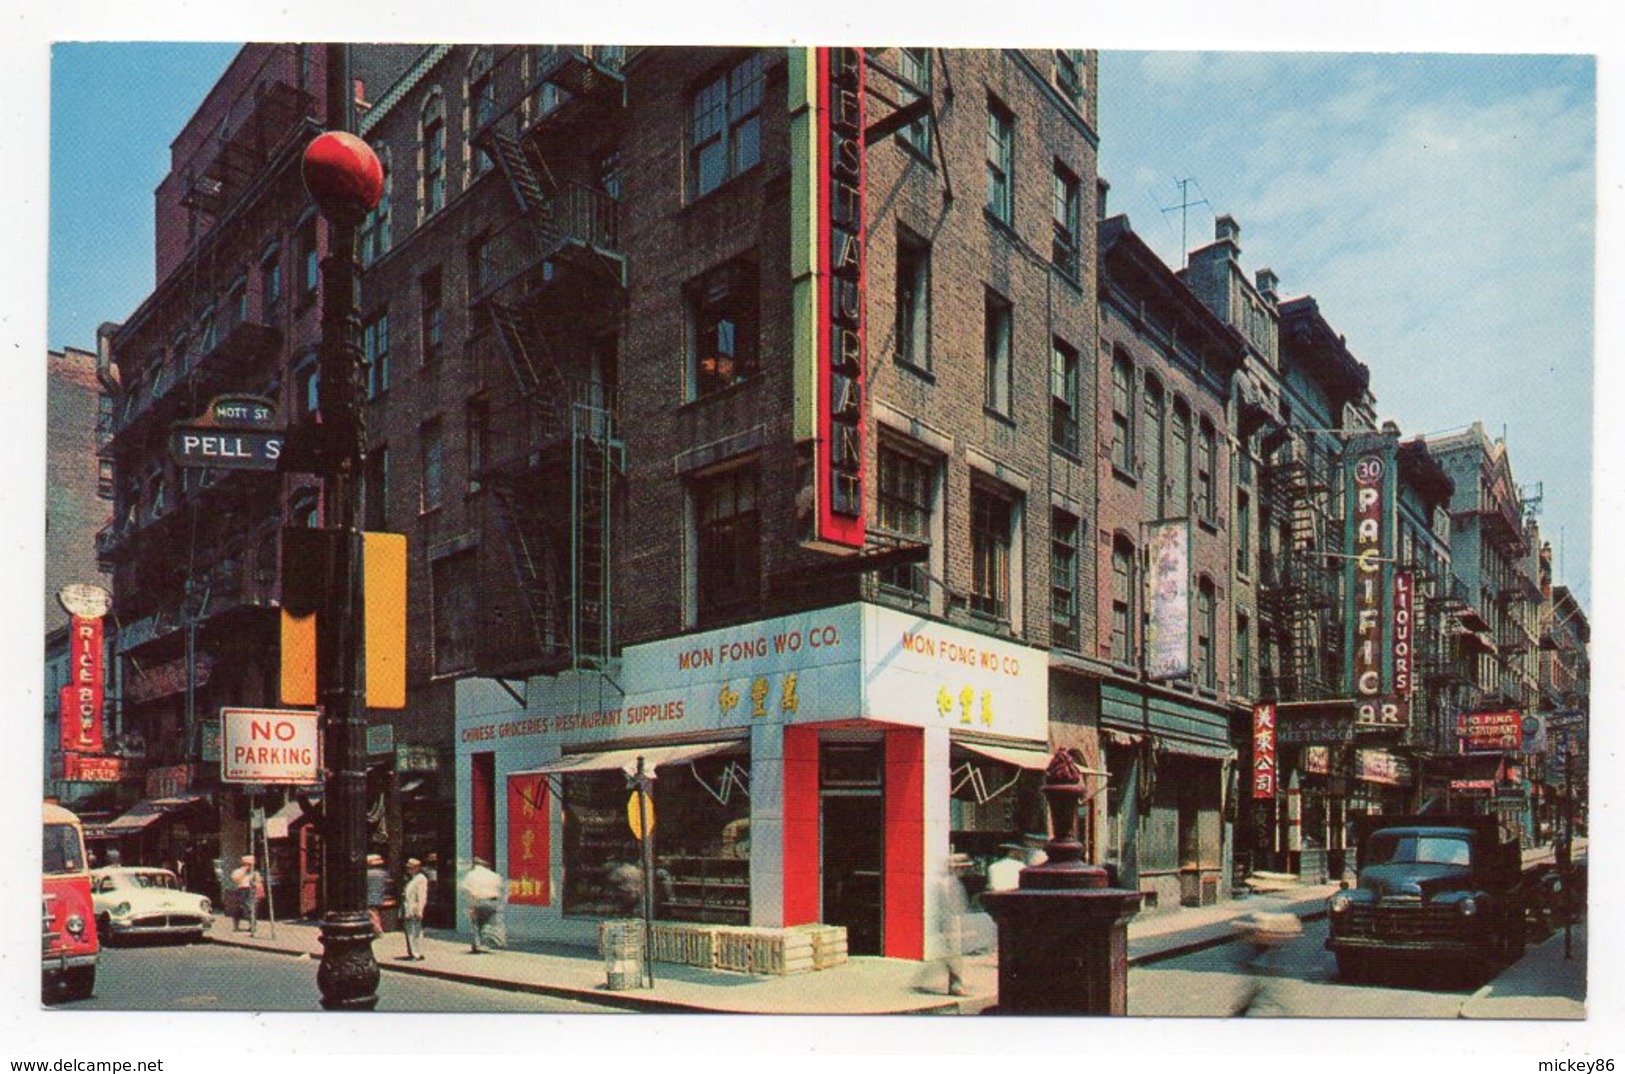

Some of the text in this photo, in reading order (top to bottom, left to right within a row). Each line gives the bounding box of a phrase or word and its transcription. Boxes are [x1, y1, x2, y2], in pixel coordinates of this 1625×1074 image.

[217, 406, 268, 419] MOTT ST
[183, 435, 284, 459] PELL S
[1359, 461, 1380, 478] 30
[1358, 488, 1380, 694] PACIFIC
[678, 625, 839, 671] MON FONG WO CO.
[1396, 577, 1409, 689] LIQUORS
[903, 632, 935, 657] MON
[939, 641, 976, 666] FONG
[980, 651, 998, 673] WO
[251, 720, 295, 742] NO
[462, 701, 684, 743] CHINESE GROCERIES RESTAURANT SUPPLIES
[235, 746, 311, 765] PARKING
